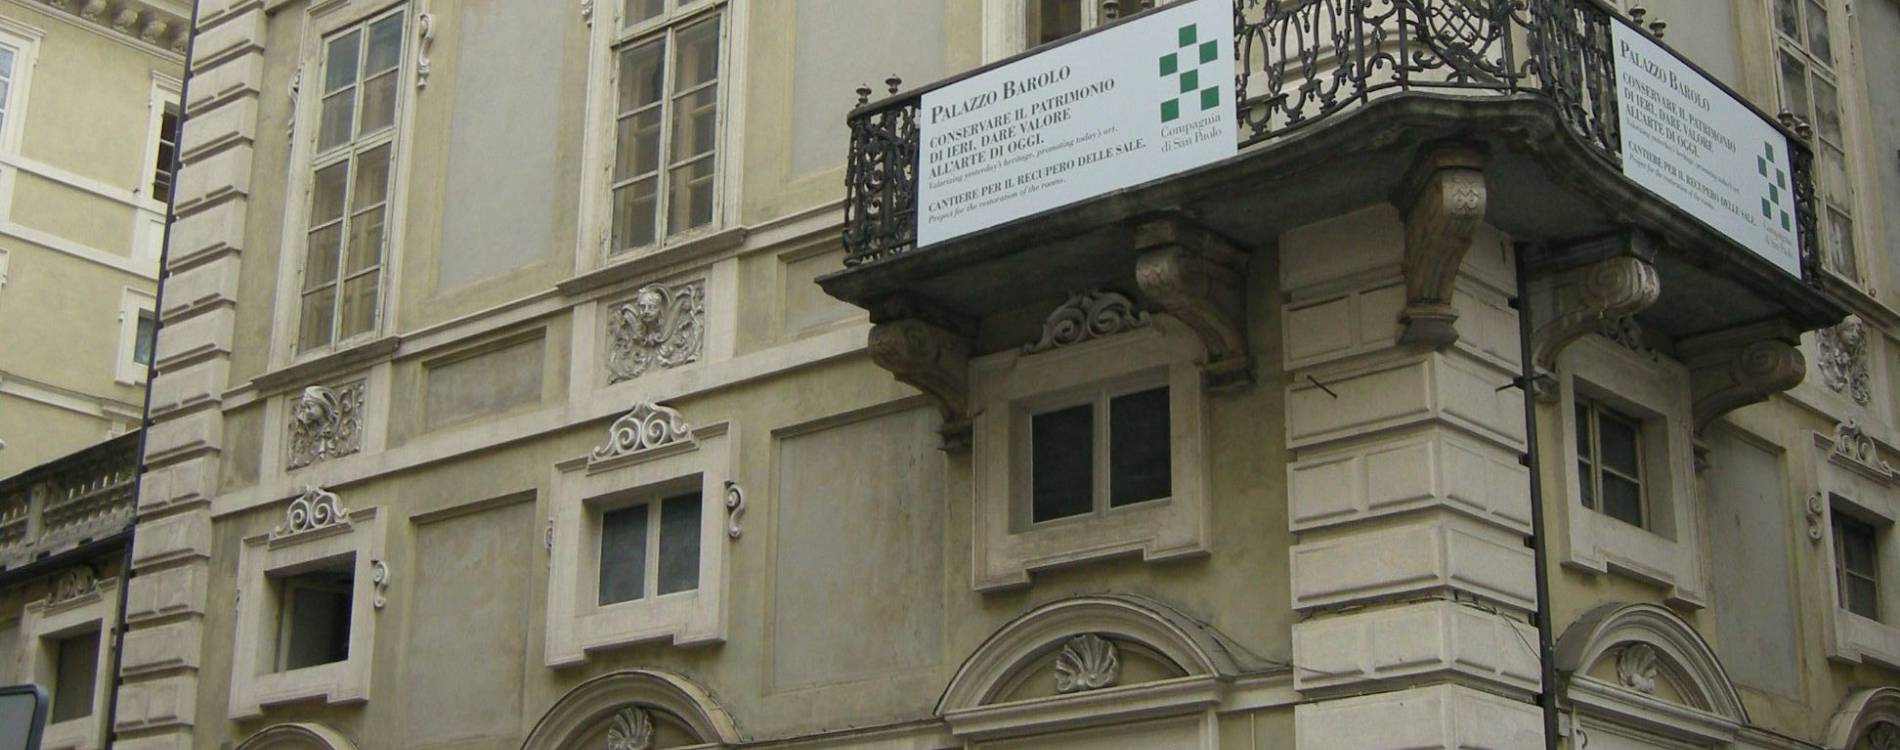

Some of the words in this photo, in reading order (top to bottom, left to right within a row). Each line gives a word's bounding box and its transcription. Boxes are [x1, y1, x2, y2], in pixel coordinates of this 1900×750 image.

[930, 90, 997, 124] PALAZZO
[1003, 65, 1071, 100] BAROLO
[930, 112, 1012, 149] CONSERVARE
[1015, 107, 1028, 121] IL
[1031, 78, 1115, 116] PATRIMONIO
[1623, 72, 1677, 114] CONSERVARE
[1679, 107, 1688, 121] IL
[1688, 114, 1736, 153] PATRIMONIO
[1624, 87, 1634, 102] DI
[1659, 109, 1682, 132] DARE
[1683, 124, 1713, 152] VALORE
[929, 151, 945, 165] DI
[981, 127, 1017, 147] DARE
[1020, 108, 1072, 135] VALORE
[1160, 113, 1221, 138] Compagnia
[1161, 141, 1171, 153] di
[1173, 137, 1192, 150] San
[1194, 127, 1222, 144] Paolo
[1665, 128, 1676, 144] DI
[929, 150, 986, 179] ALL'ARTE
[990, 145, 1005, 160] DI
[1008, 133, 1045, 154] OGGI.
[929, 190, 979, 212] CANTIERE
[981, 181, 1002, 197] PER
[1004, 178, 1015, 189] IL
[1017, 160, 1075, 186] RECUPERO
[1077, 148, 1114, 167] DELLE
[1115, 137, 1146, 155] SALE.
[1628, 142, 1662, 167] CANTIERE
[1663, 160, 1677, 177] PER
